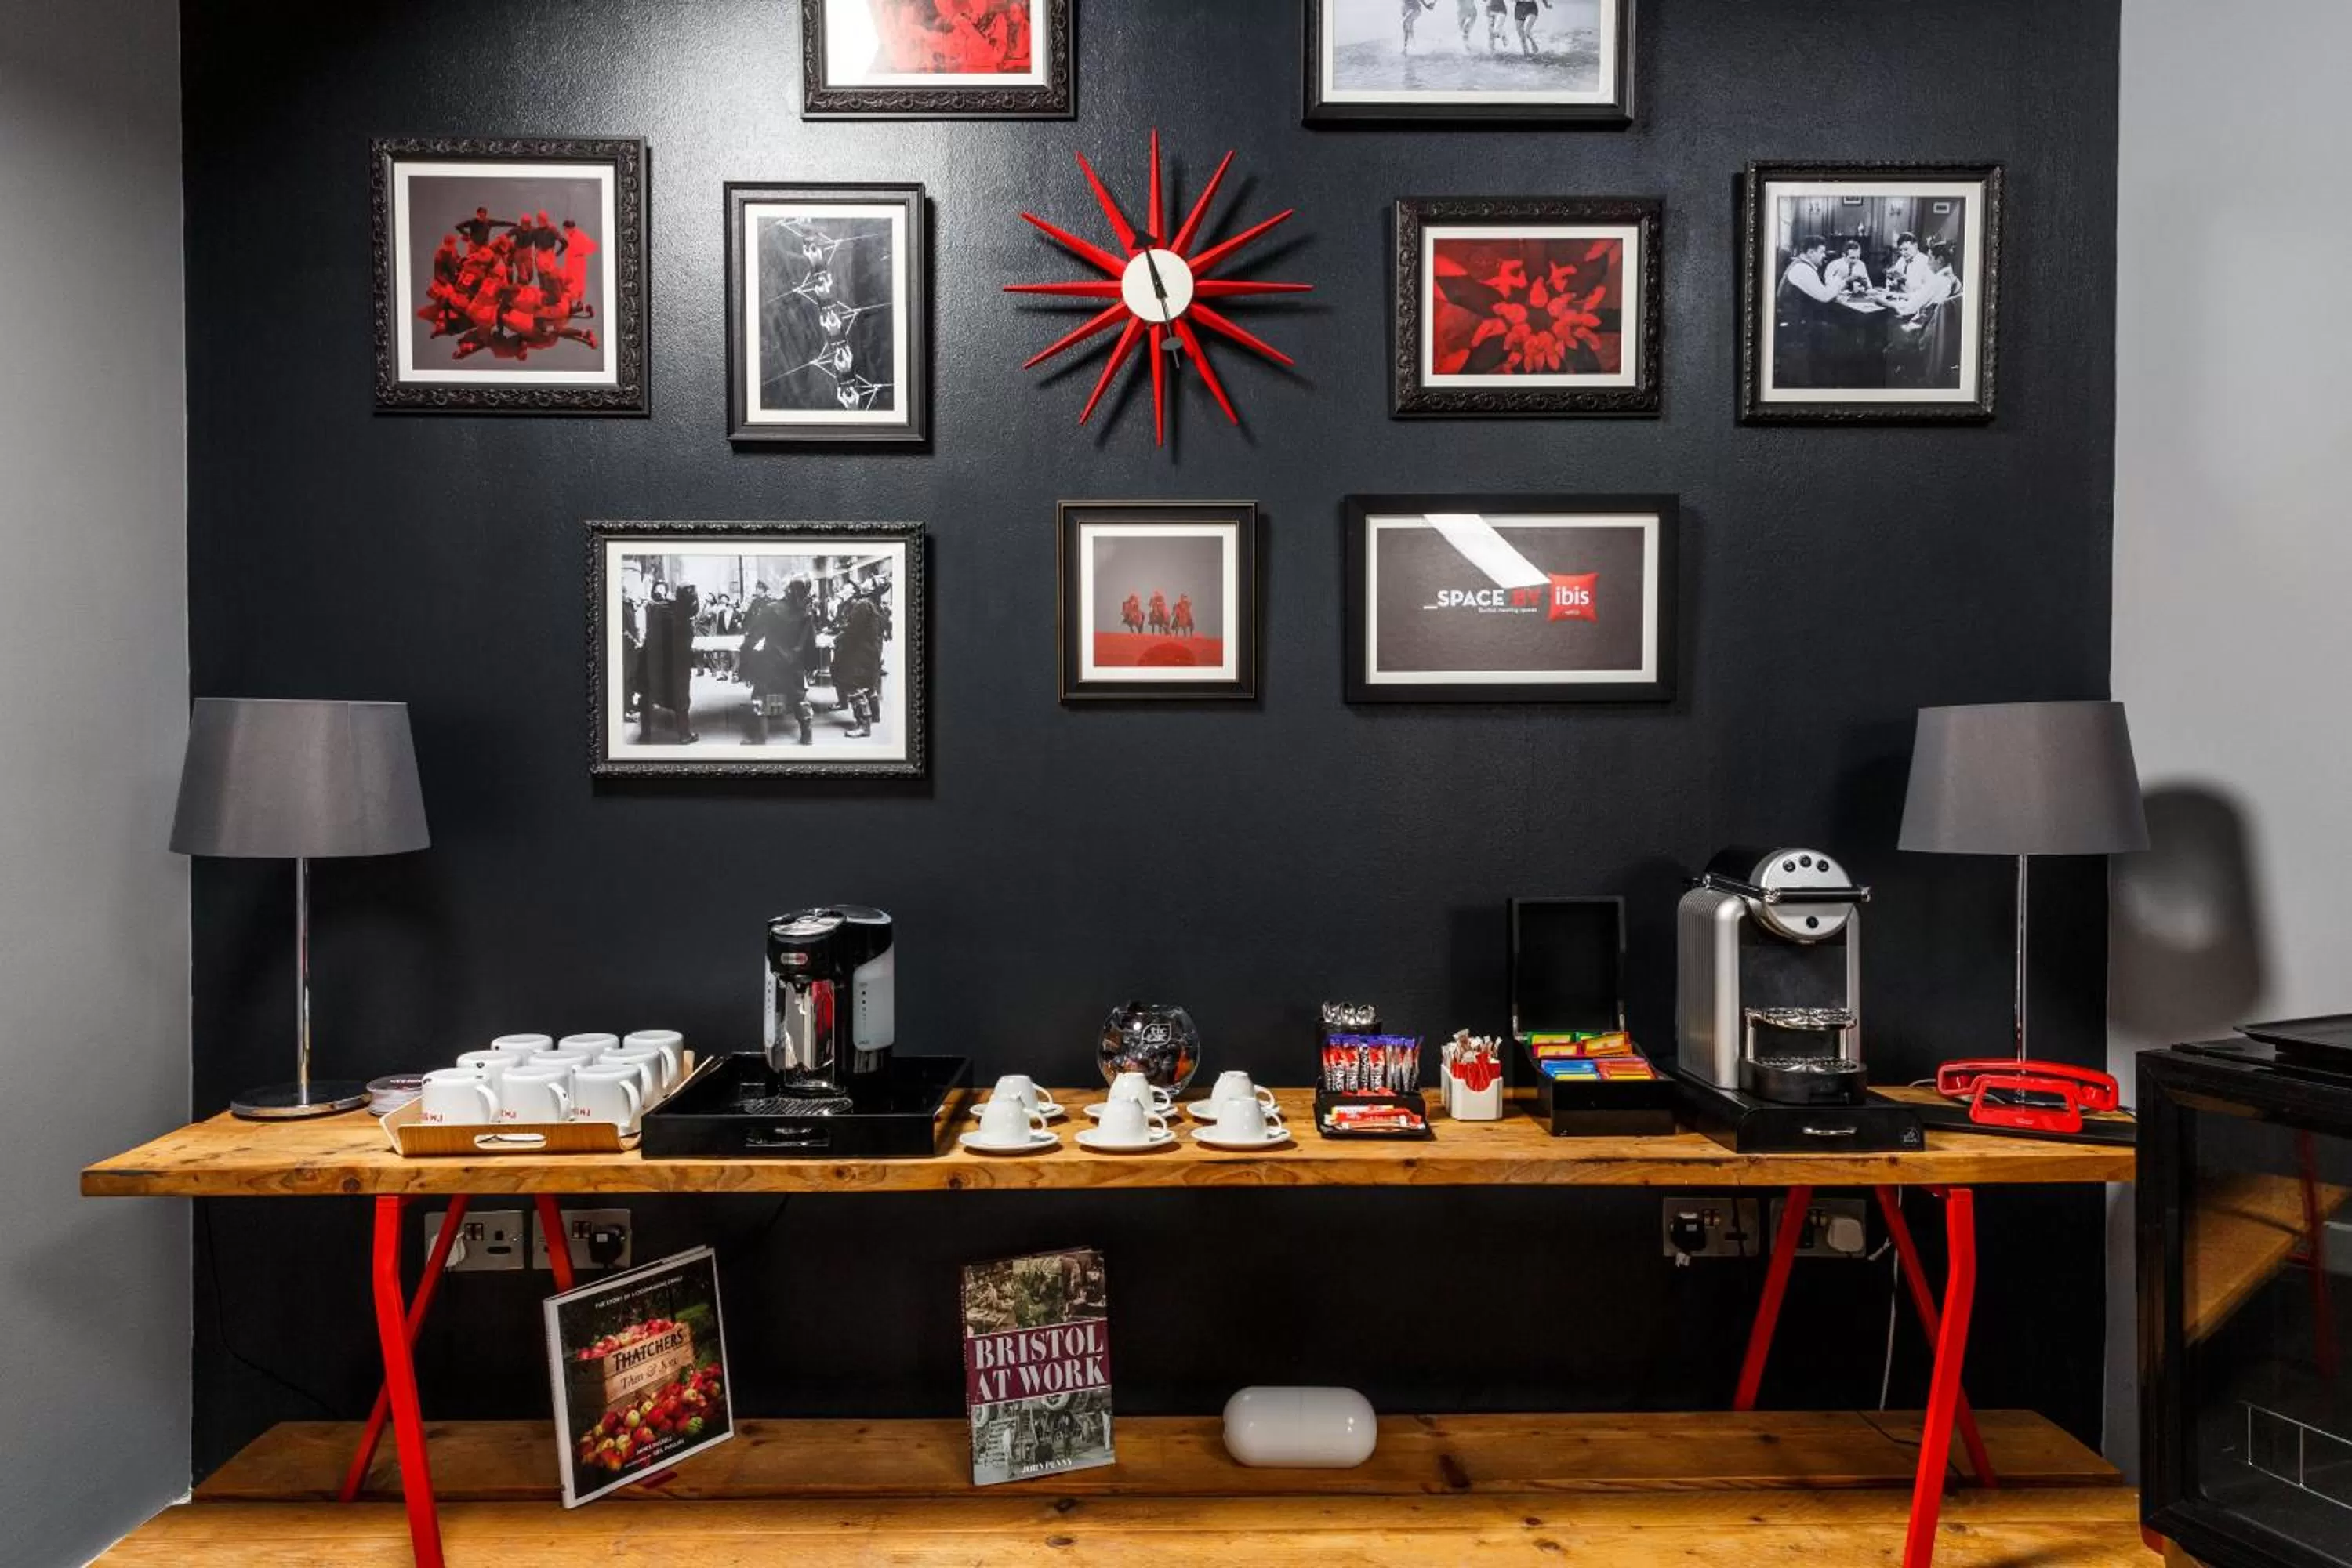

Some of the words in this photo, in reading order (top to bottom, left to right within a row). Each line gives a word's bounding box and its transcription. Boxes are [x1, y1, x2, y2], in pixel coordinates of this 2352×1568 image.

[1555, 586, 1590, 606] ibis
[612, 1328, 684, 1371] THATCHERS
[975, 1324, 1104, 1370] BRISTOL
[975, 1368, 1011, 1402] AT
[1018, 1355, 1107, 1395] WORK
